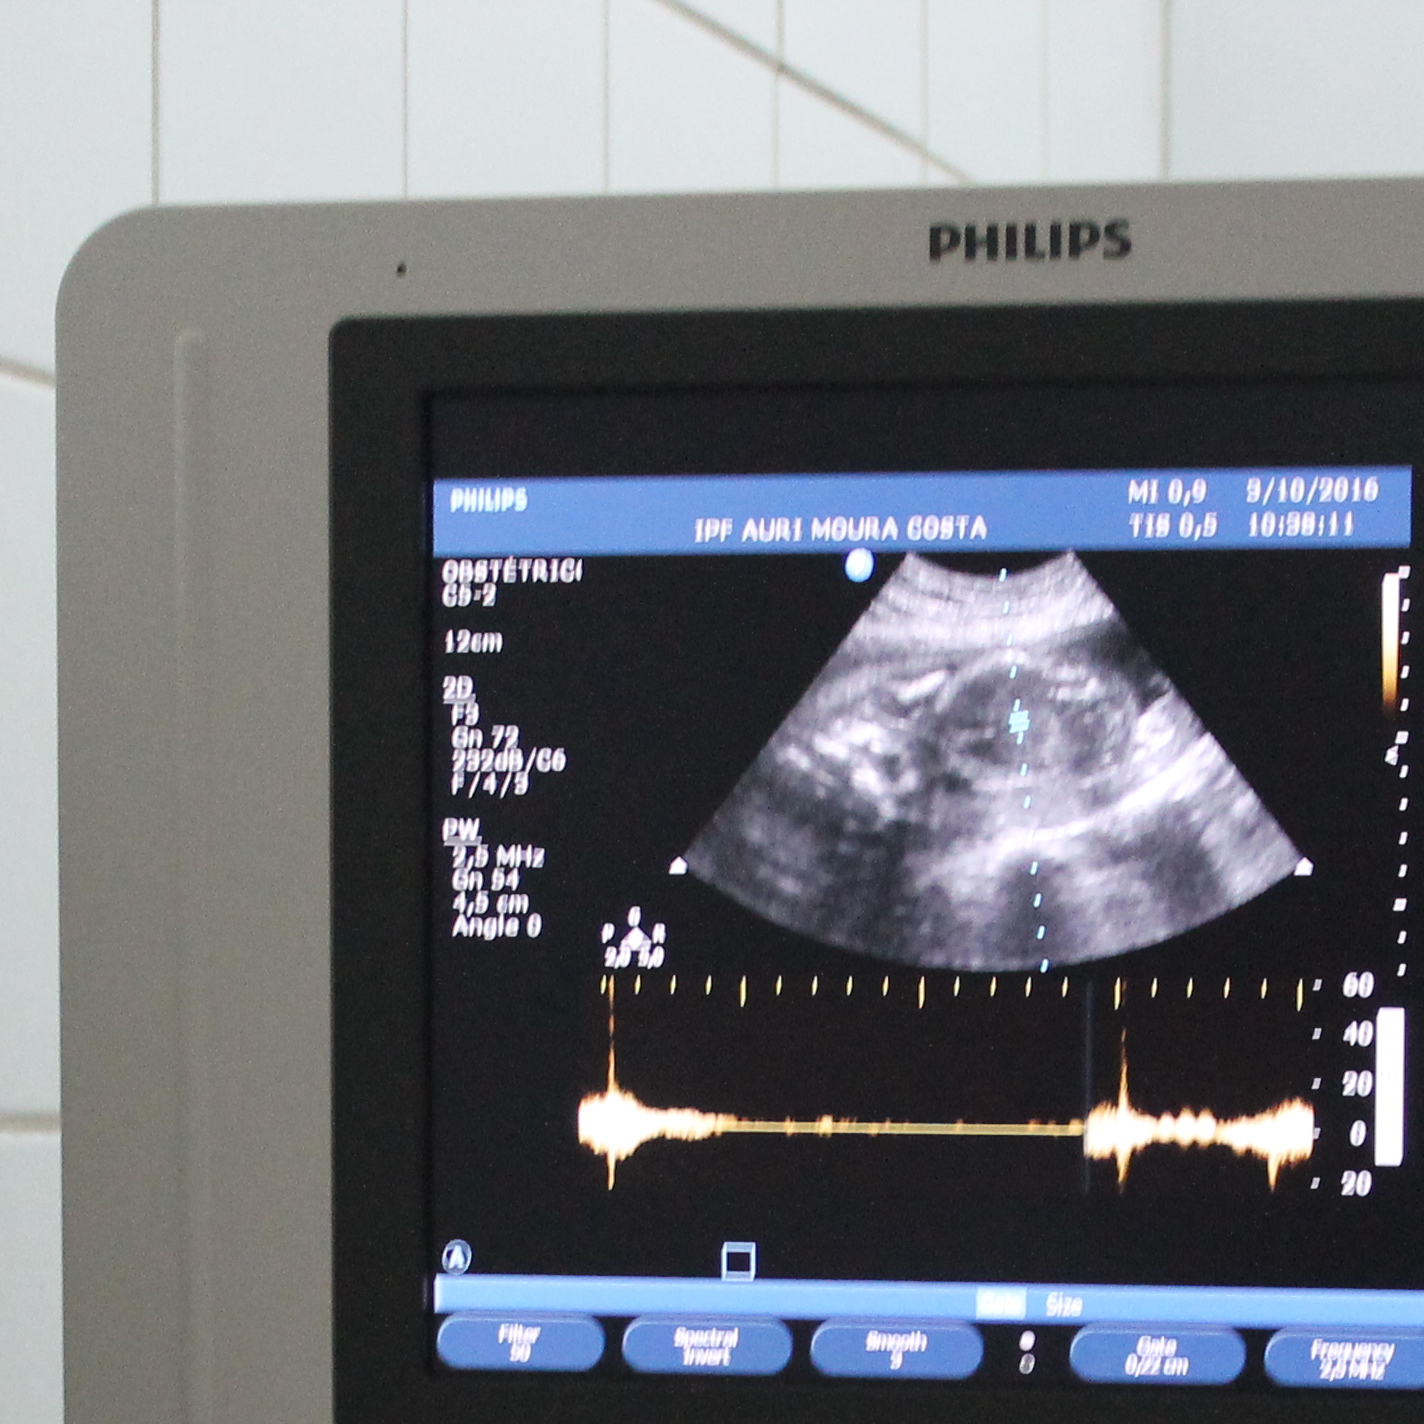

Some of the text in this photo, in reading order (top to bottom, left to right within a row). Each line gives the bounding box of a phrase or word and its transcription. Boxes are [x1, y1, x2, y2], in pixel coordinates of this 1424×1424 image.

[928, 221, 1133, 264] PHILIPS
[450, 486, 528, 514] PHILIPS
[1128, 478, 1159, 505] MI
[694, 514, 988, 543] IPF AURI MOURA COSTA
[442, 817, 481, 842] PW
[496, 844, 545, 868] MHz
[452, 912, 520, 941] Angle
[1342, 971, 1375, 998] 60
[1342, 1020, 1374, 1047] 40
[1342, 1070, 1373, 1097] 20
[1349, 1119, 1367, 1147] 0
[1340, 1169, 1372, 1197] 20
[498, 1323, 541, 1344] Filter
[674, 1326, 740, 1349] Spectral
[865, 1330, 928, 1352] Smooth
[1310, 1337, 1396, 1364] Frequency
